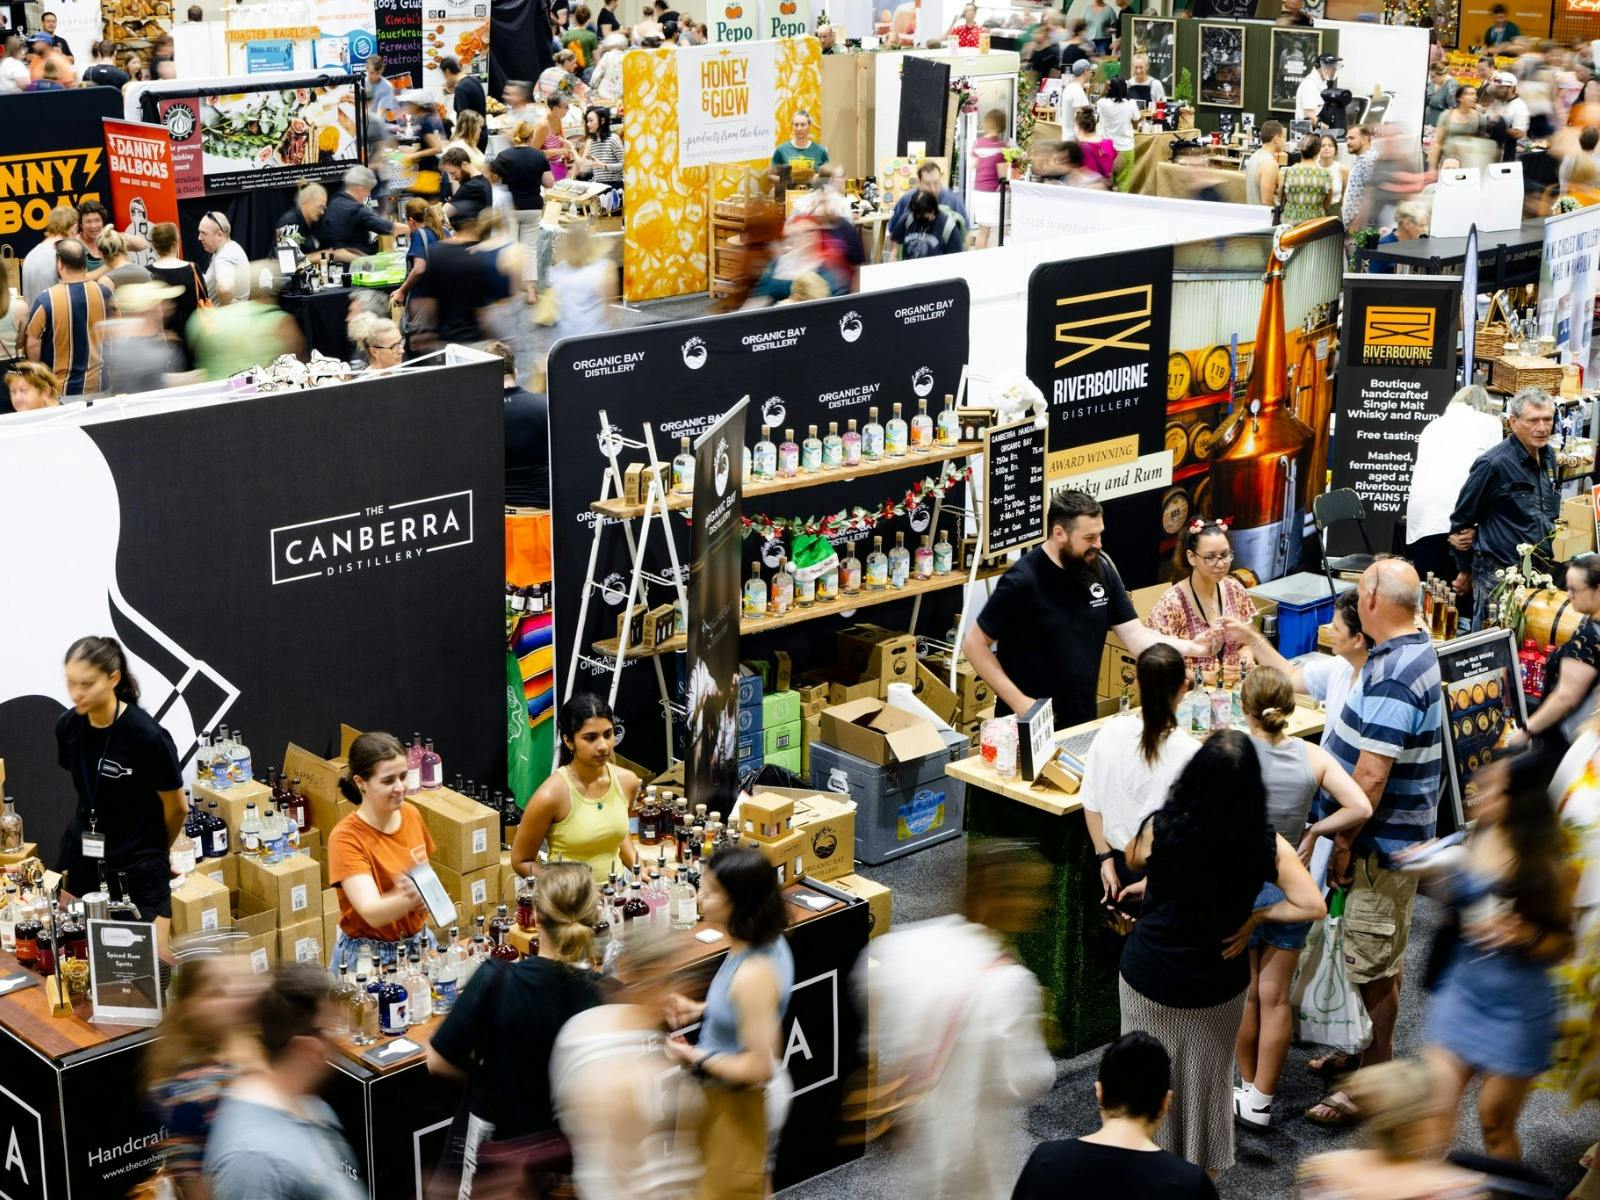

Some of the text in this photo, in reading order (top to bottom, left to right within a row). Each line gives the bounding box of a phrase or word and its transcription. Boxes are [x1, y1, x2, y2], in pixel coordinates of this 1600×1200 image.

[716, 22, 752, 42] Pepo
[771, 17, 805, 38] Pepo
[701, 58, 748, 89] HONEY
[683, 131, 719, 151] products
[117, 139, 160, 160] DANNY
[110, 155, 169, 179] BALBOA'S
[0, 158, 78, 198] NNY
[894, 299, 954, 318] ORGANIC BAY
[904, 310, 946, 325] DISTILLERY
[742, 327, 807, 345] ORGANIC BAY
[752, 337, 798, 352] DISTILLERY
[1363, 345, 1433, 359] RIVERBOURNE
[573, 351, 645, 371] ORGANIC BAY
[1363, 358, 1432, 366] DISTILLERY
[585, 363, 636, 378] DISTILLERY
[1210, 363, 1225, 379] 118
[1053, 363, 1149, 405] RIVERBOURNE
[1370, 379, 1421, 390] Boutique
[819, 383, 881, 403] ORGANIC BAY
[1361, 389, 1429, 400] handcrafted
[828, 394, 873, 410] DISTILLERY
[1062, 397, 1139, 421] DISTILLERY
[1363, 400, 1425, 411] Single Malt
[1347, 409, 1439, 421] Whisky and Rum
[660, 416, 706, 433] ORGANIC
[671, 425, 712, 439] DISTILLE
[1022, 438, 1033, 447] BAY
[1357, 430, 1422, 443] Free tasting
[1049, 444, 1133, 473] AWARD WINNING
[1368, 452, 1413, 462] Mashed,
[1349, 461, 1407, 472] fermented
[1105, 470, 1131, 491] and
[1134, 466, 1163, 485] Rum
[1368, 472, 1410, 482] aged at
[1355, 481, 1411, 492] Riverbour
[365, 505, 384, 517] THE
[1373, 502, 1401, 512] NSW
[285, 509, 461, 565] CANBERRA
[327, 548, 423, 576] DISTILLERY
[88, 1125, 170, 1168] Handcraft
